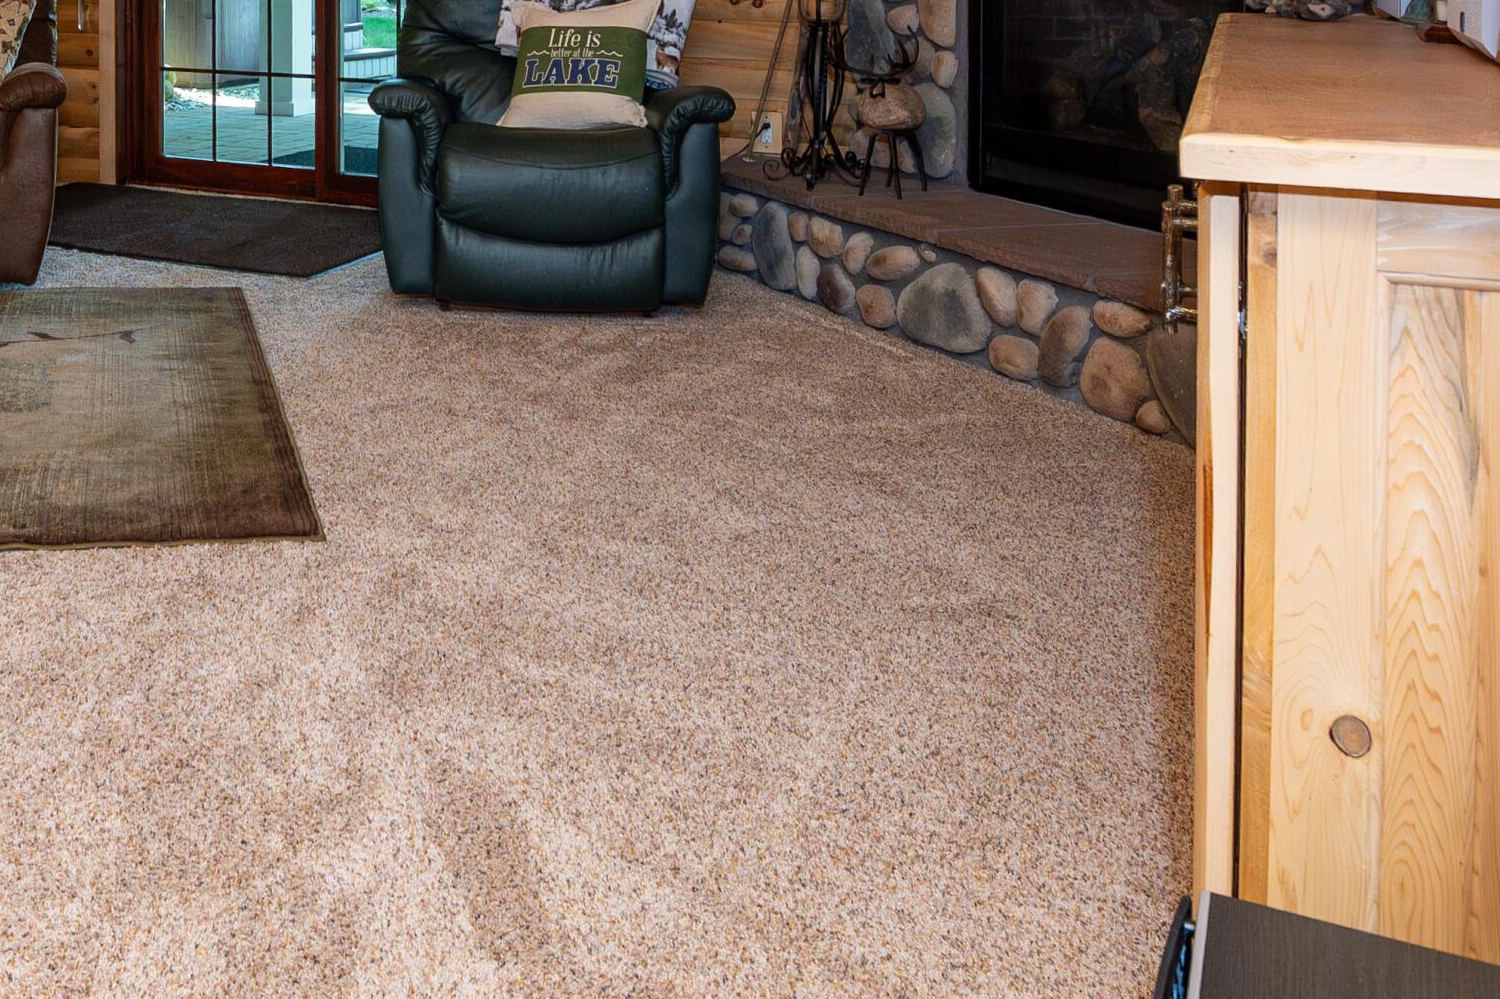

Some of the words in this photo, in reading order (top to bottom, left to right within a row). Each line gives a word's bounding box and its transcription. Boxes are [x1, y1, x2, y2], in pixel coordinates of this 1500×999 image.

[548, 28, 581, 48] Life
[585, 30, 601, 48] is
[550, 47, 572, 58] better
[582, 48, 595, 58] the
[522, 57, 621, 89] LAKE
